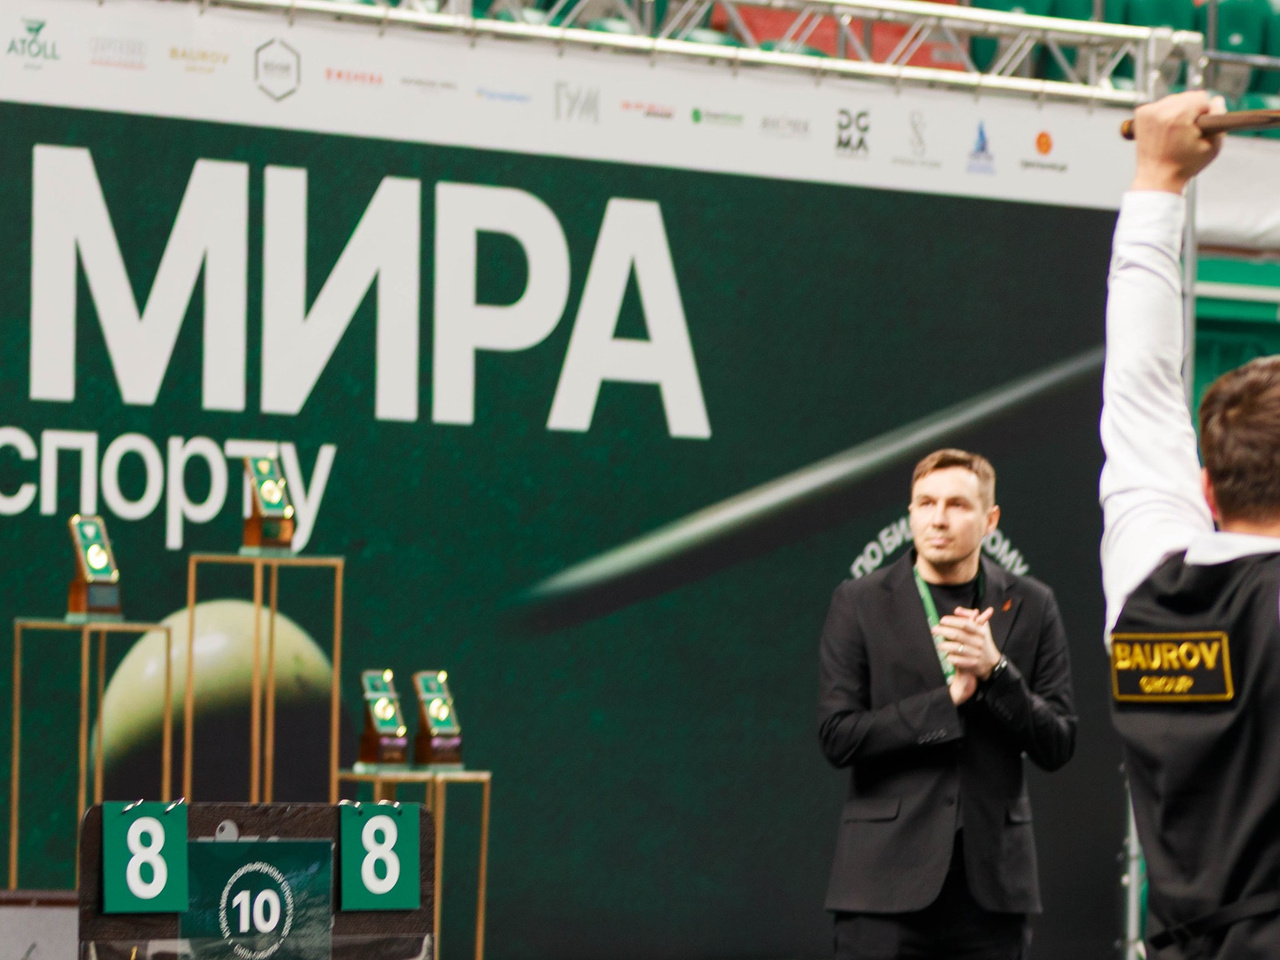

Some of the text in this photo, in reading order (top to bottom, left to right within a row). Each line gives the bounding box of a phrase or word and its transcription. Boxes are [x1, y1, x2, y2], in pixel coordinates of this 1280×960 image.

[7, 38, 60, 60] ATOLL
[30, 144, 711, 440] МИРА
[0, 427, 337, 552] спорту
[1114, 641, 1221, 671] BAUROV
[1139, 675, 1195, 694] GROUP
[126, 816, 168, 899] 8
[360, 814, 400, 895] 8
[232, 888, 281, 934] 10
